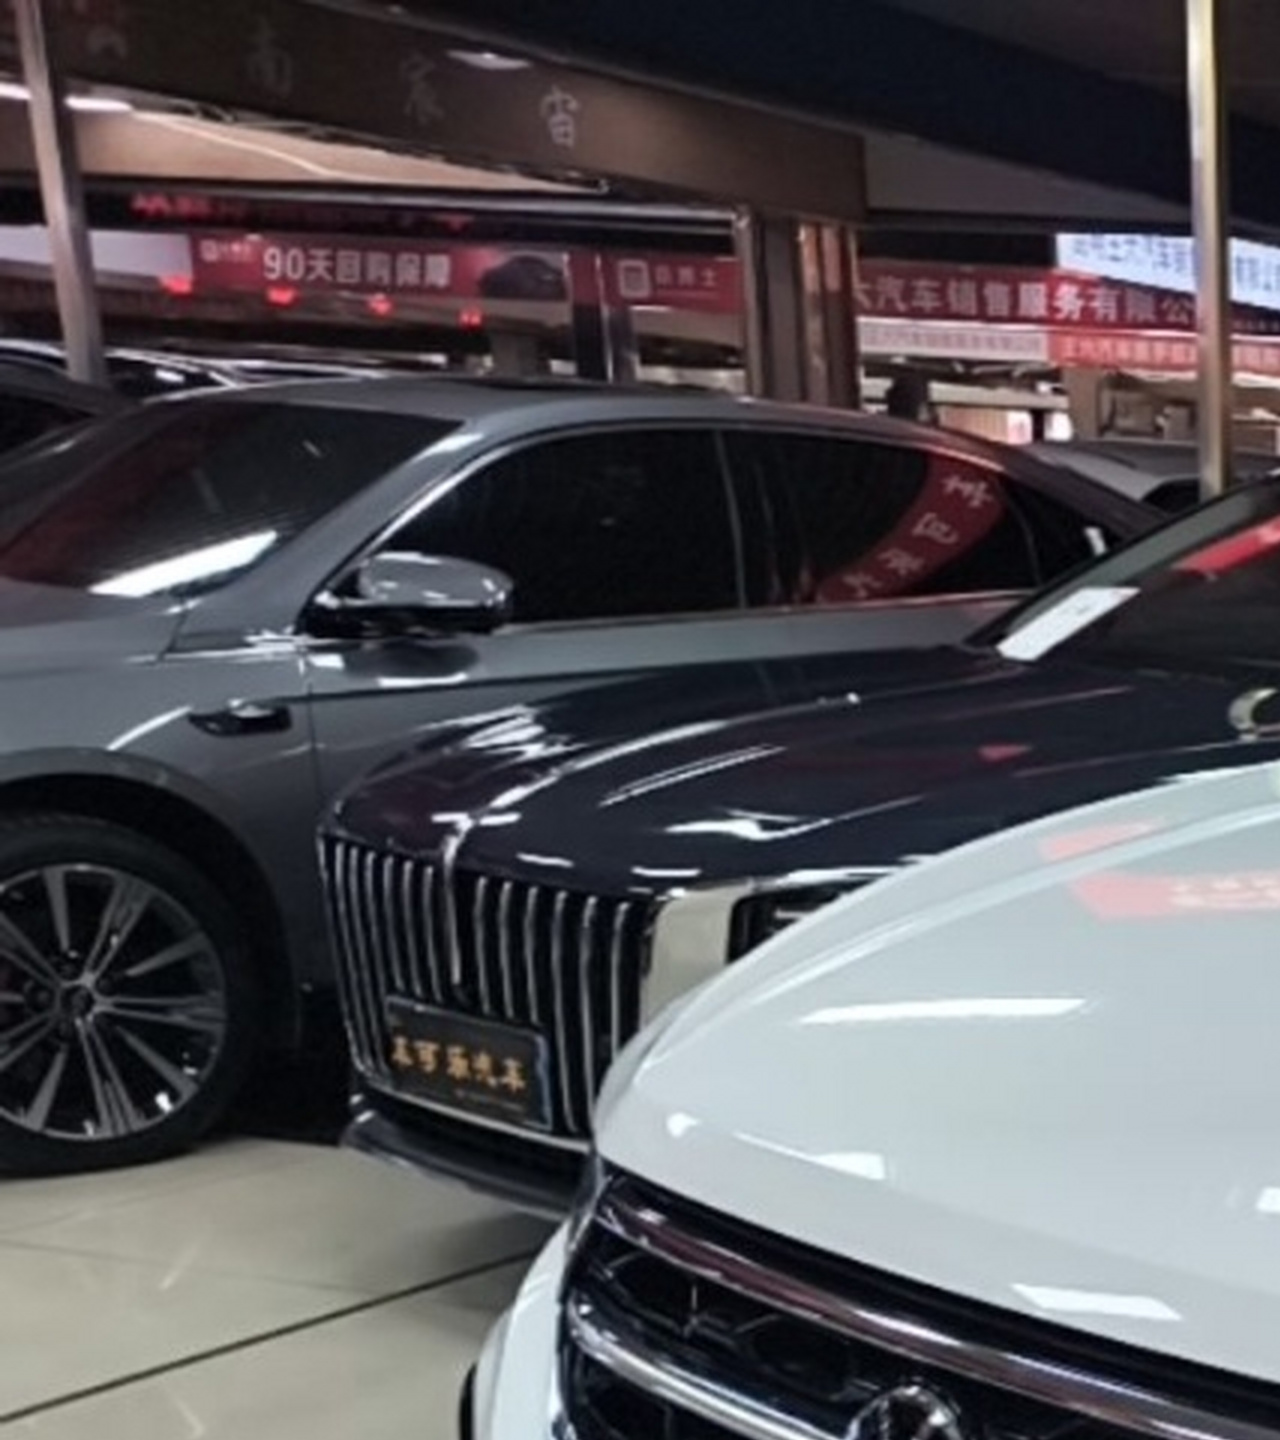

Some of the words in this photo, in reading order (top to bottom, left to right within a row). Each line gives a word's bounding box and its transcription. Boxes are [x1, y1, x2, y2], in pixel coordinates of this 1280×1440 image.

[263, 246, 451, 289] 90天回购保障
